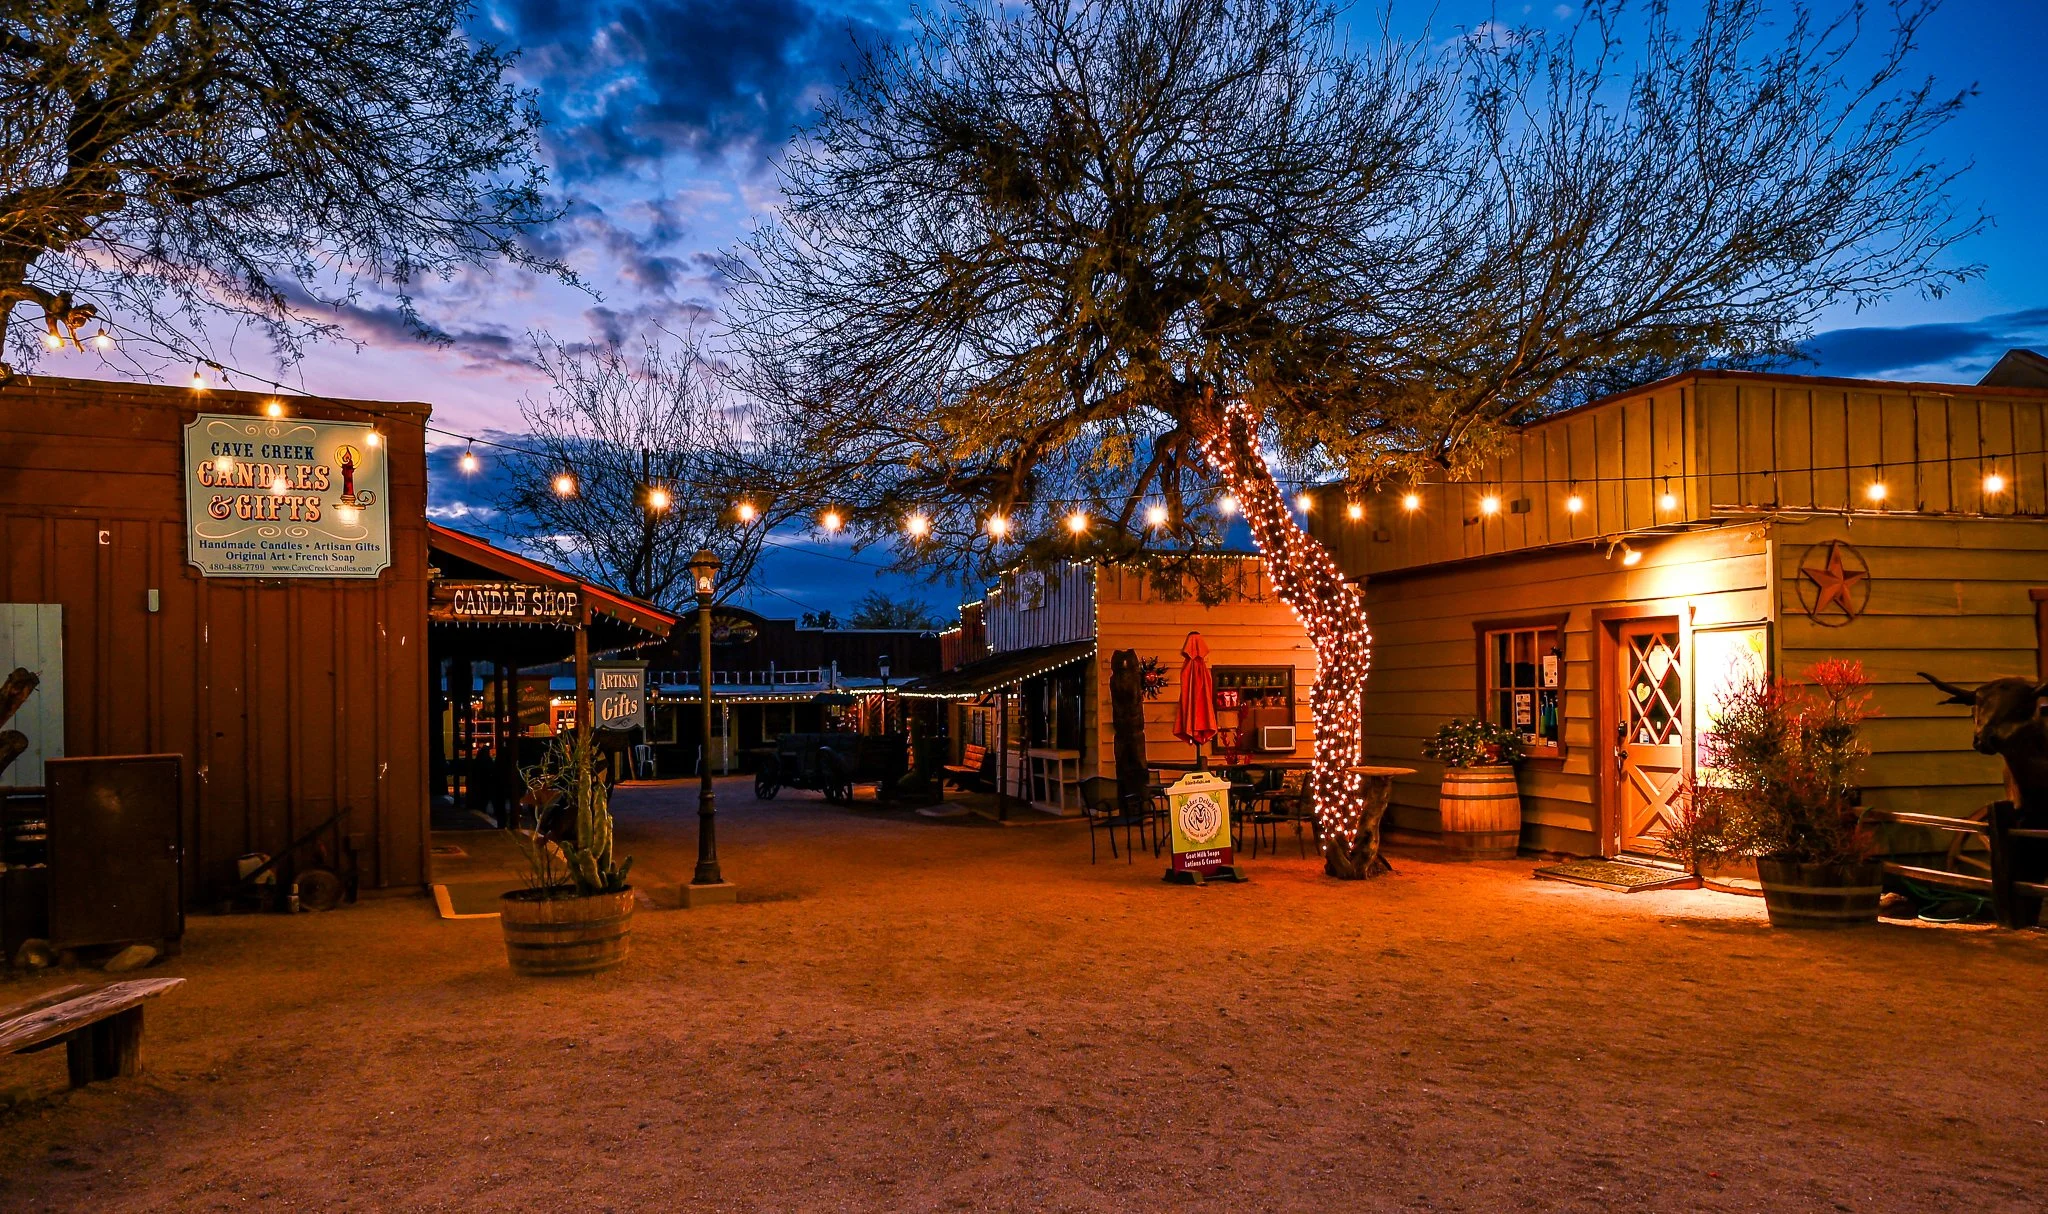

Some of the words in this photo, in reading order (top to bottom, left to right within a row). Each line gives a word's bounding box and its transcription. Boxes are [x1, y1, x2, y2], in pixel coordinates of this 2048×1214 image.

[211, 442, 253, 458] CAVE
[261, 444, 315, 460] CREEK
[196, 460, 330, 492] CANDLES
[199, 540, 256, 550] Handmade
[260, 541, 303, 551] Candles
[314, 542, 351, 551] Artisan
[355, 543, 380, 552] Gifts
[226, 551, 267, 562] Original
[270, 552, 286, 561] Art
[295, 552, 328, 562] French
[331, 553, 355, 563] Soap
[209, 563, 265, 571] 480-488-7799
[271, 564, 372, 573] www.CaveCreekCandles.com
[454, 590, 526, 616] CANDLE
[532, 591, 578, 616] SHOP
[600, 672, 638, 690] ARTISAN
[601, 693, 638, 720] Gifts
